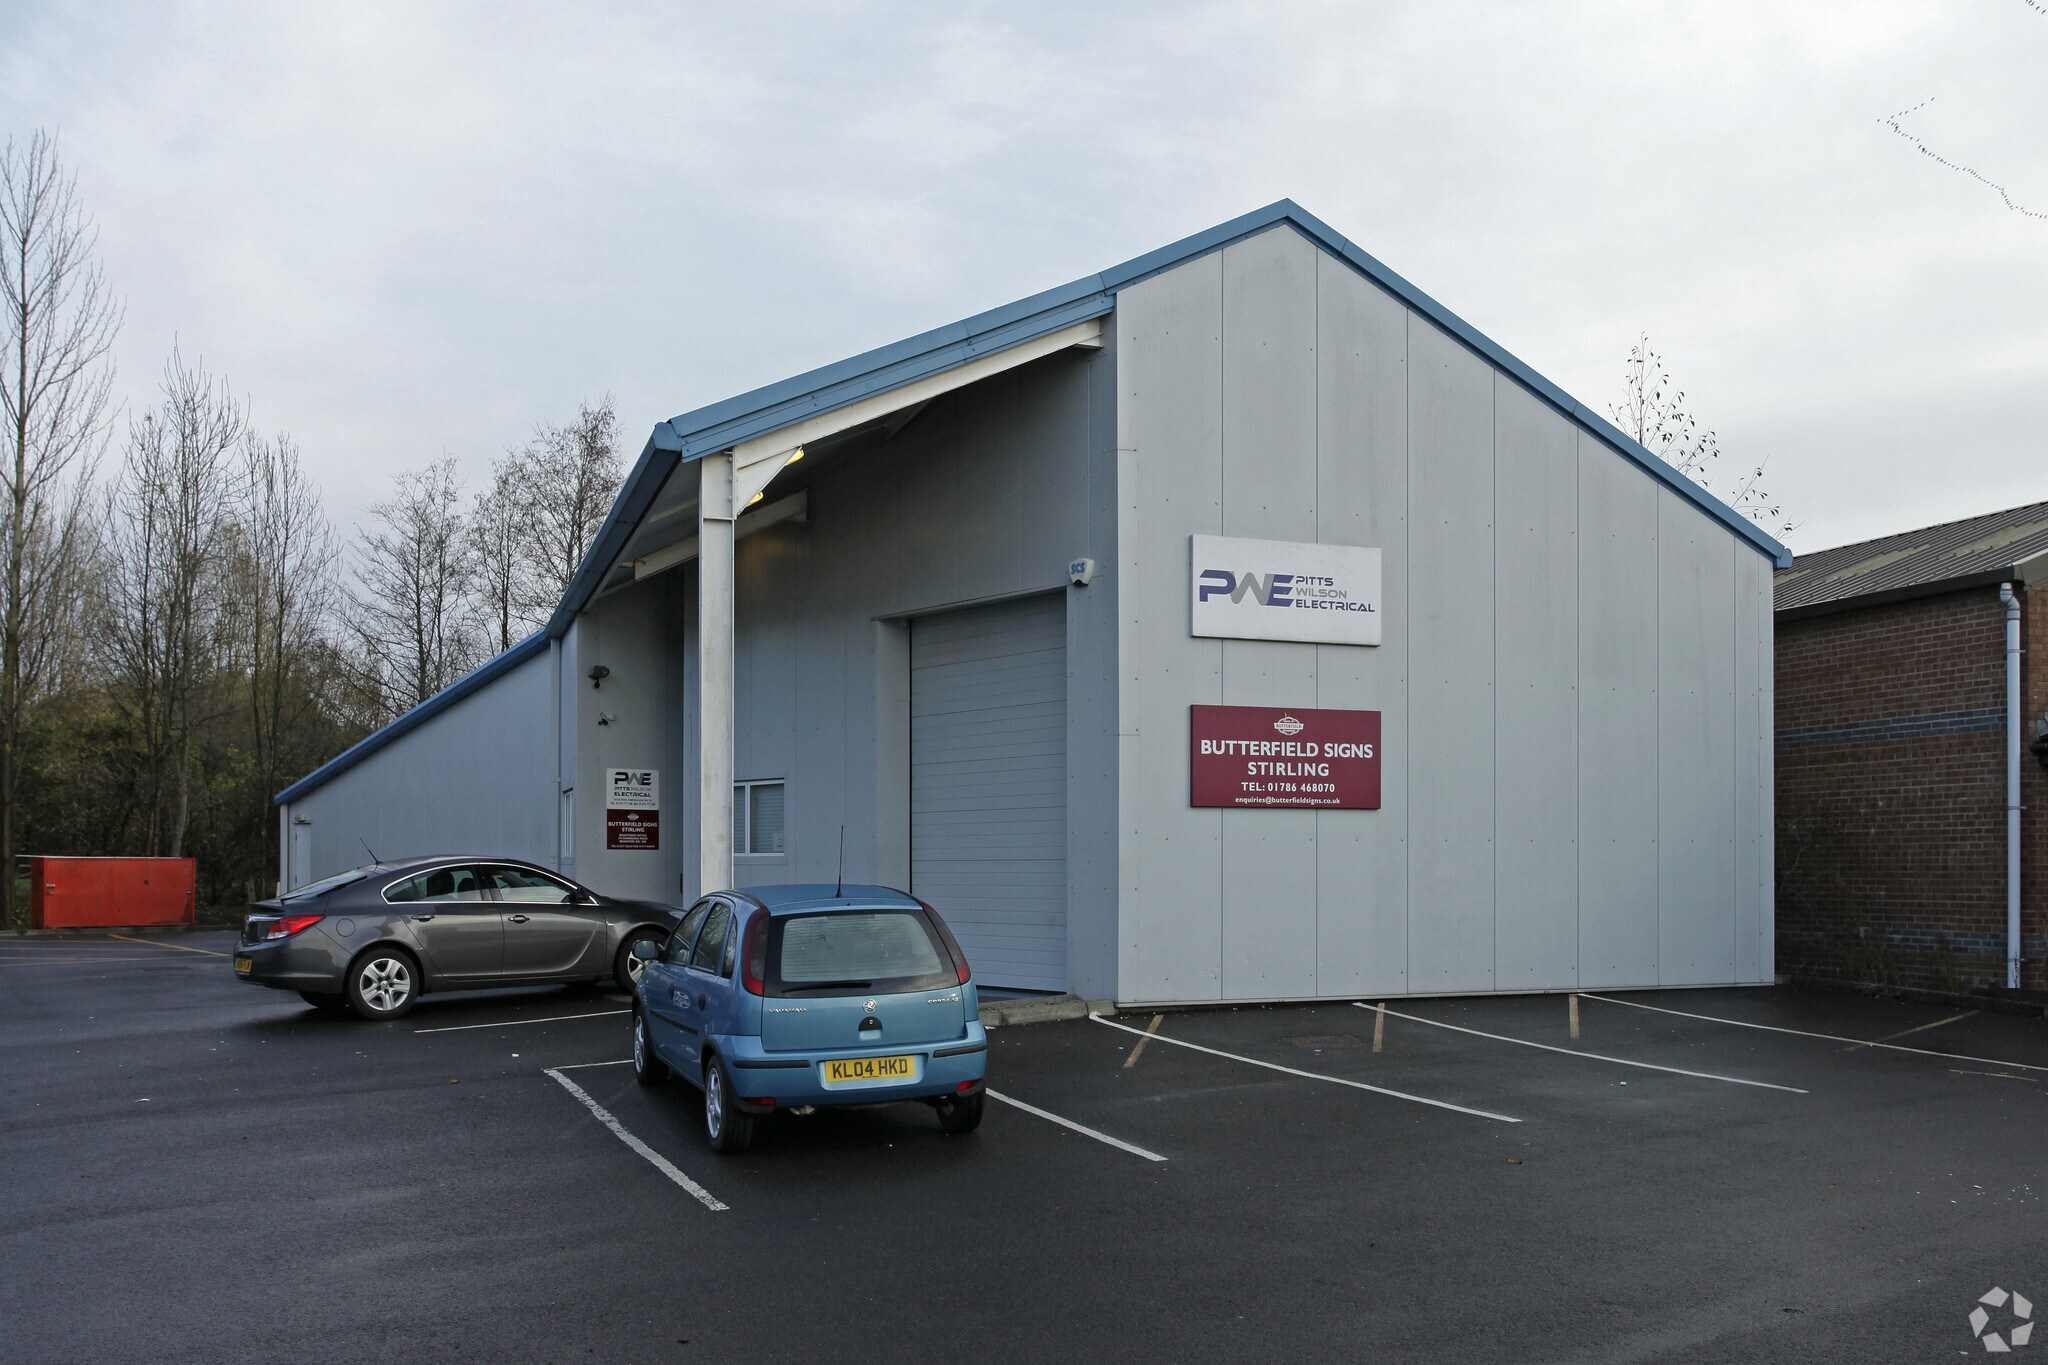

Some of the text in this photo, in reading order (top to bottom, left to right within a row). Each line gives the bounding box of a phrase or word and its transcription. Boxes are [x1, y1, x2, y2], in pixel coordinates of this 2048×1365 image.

[1199, 569, 1295, 607] PWE
[1295, 575, 1334, 587] PITTS
[1295, 587, 1348, 599] WILSON
[1295, 599, 1376, 613] ELECTRICAL
[1200, 739, 1374, 759] BUTTERFIELD SIGNS
[1247, 762, 1330, 777] STIRLING
[614, 771, 652, 786] PWE
[1241, 782, 1336, 793] TEL: 01786 468070
[1235, 796, 1341, 805] enquiries@butterfieldsigns.co.uk
[832, 1058, 908, 1079] KL04 HKD
